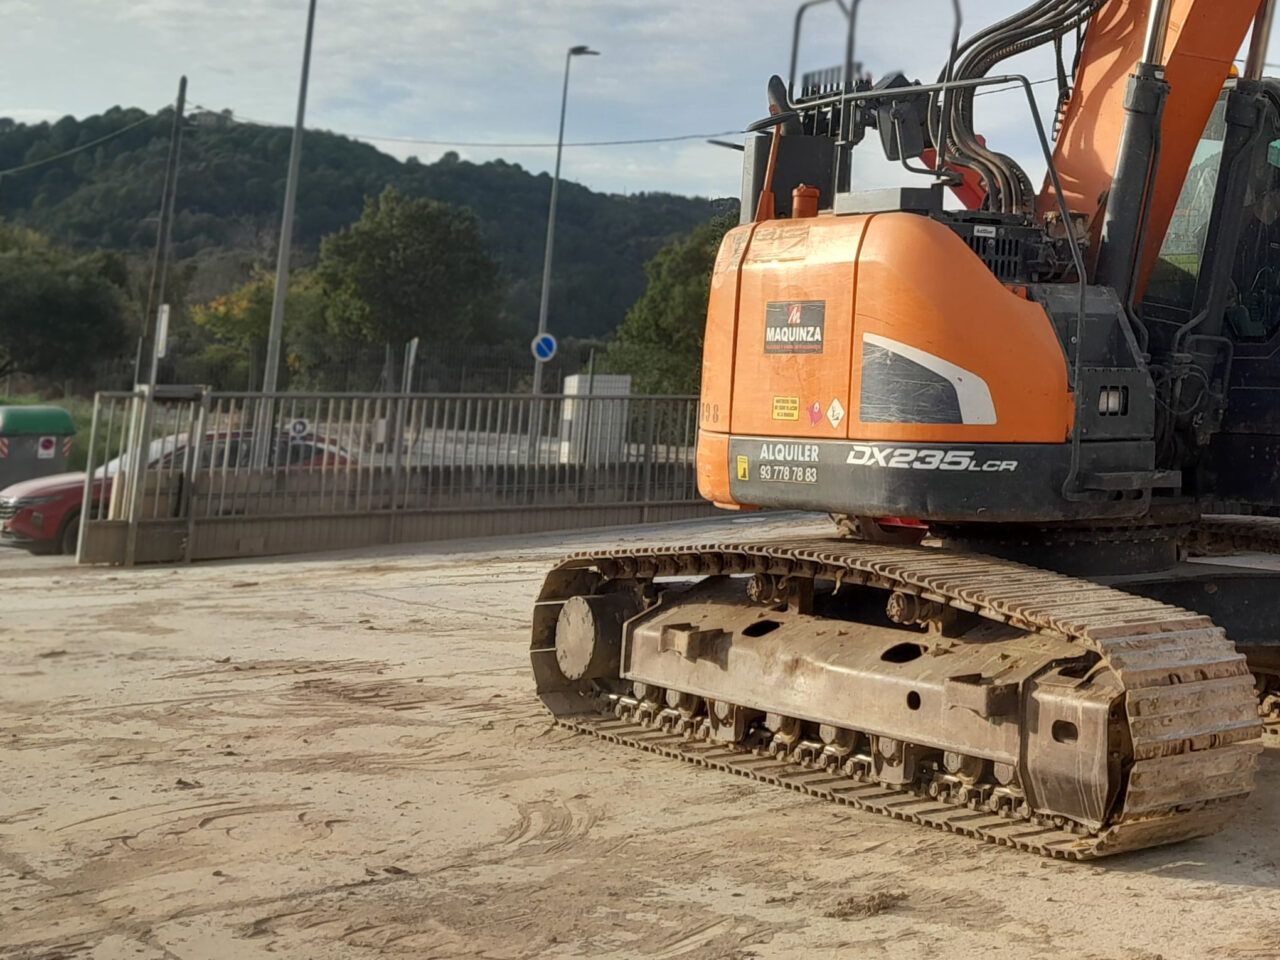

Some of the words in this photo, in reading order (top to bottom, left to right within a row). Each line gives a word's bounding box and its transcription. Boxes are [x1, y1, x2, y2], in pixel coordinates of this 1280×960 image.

[766, 326, 822, 342] MAQUINZA
[760, 443, 819, 462] ALQUILER
[760, 465, 771, 479] 93
[773, 466, 790, 480] 778
[792, 467, 804, 481] 78
[805, 468, 817, 482] 83
